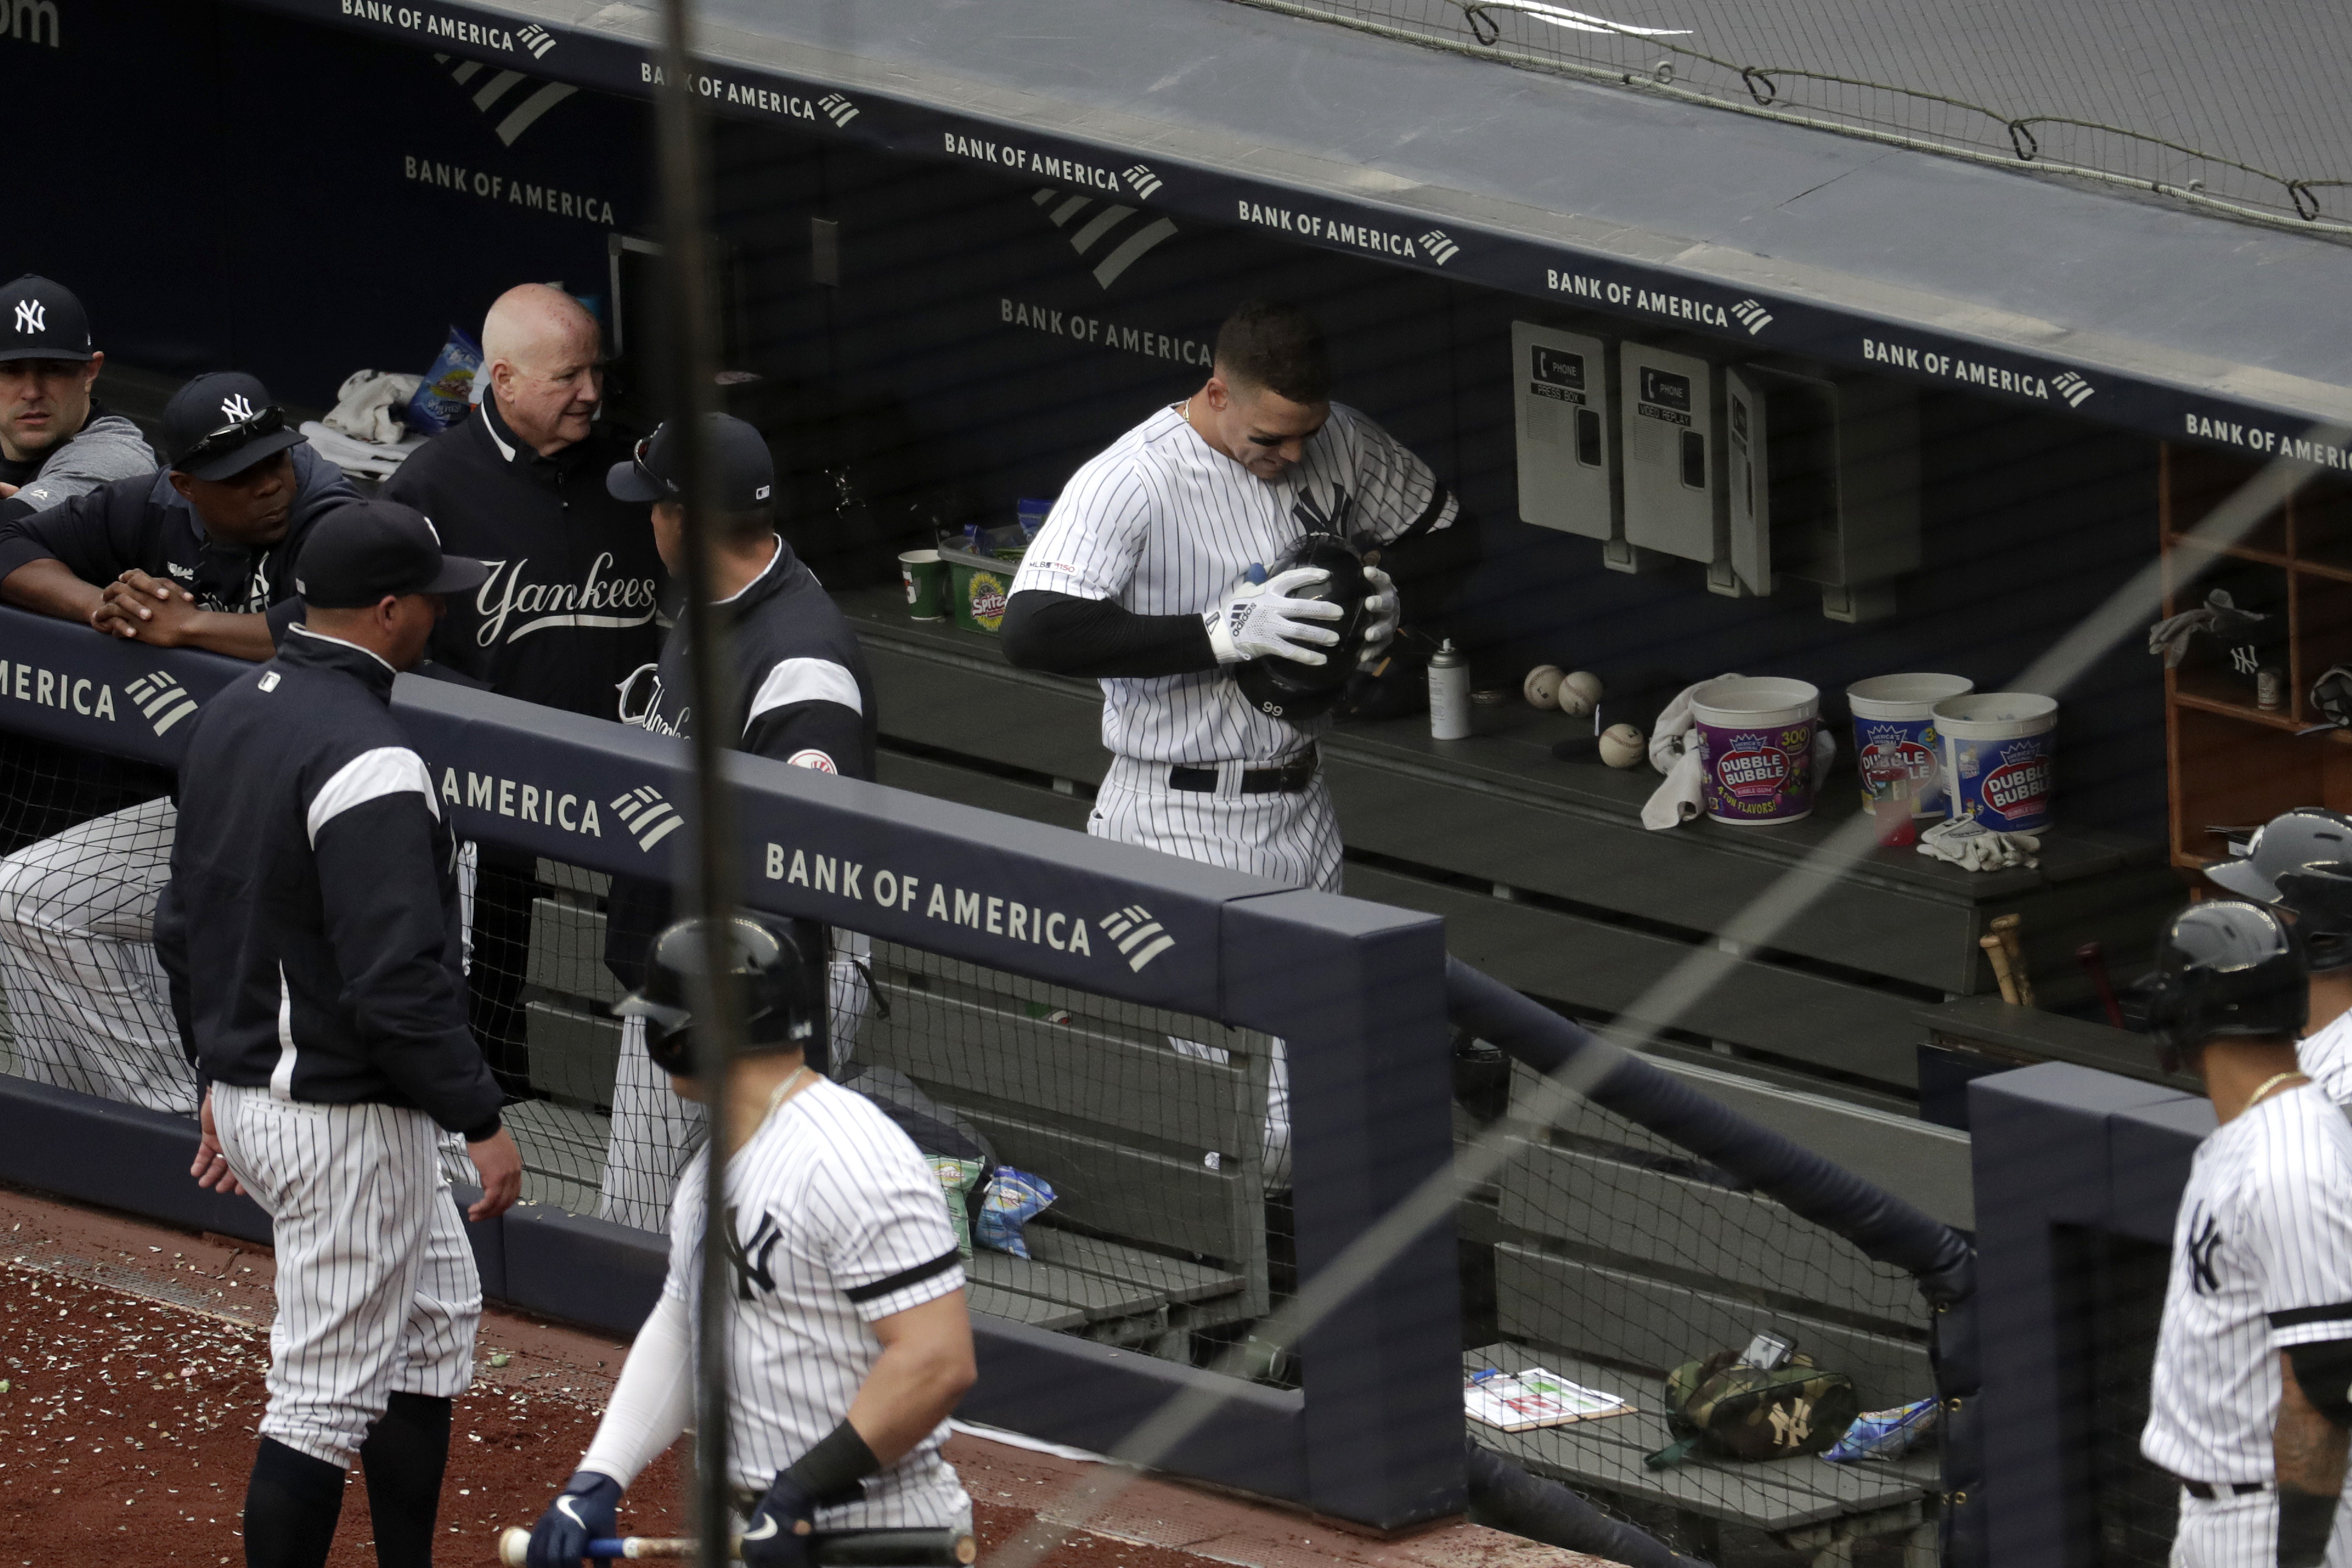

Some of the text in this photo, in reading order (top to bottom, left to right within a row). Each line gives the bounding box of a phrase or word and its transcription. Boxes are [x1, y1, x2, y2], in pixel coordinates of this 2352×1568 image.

[342, 0, 514, 52] BANK OF AMERICA
[641, 62, 815, 120] BAK OF AMERICA
[945, 132, 1119, 192] BANK OF AMERICA
[405, 155, 614, 225] BANK OF AMERICA
[1239, 201, 1416, 258] BANK OF AMERICA
[1547, 269, 1728, 328] BANK OF AMERICA
[1002, 298, 1213, 368] BANK OF AMERICA
[1553, 362, 1577, 377] PHONE
[1660, 383, 1683, 397] PHONE
[1863, 338, 2049, 400] BANK OF AMERICA
[1538, 385, 1579, 403] PRESS BOX
[1641, 405, 1690, 425] VIDEO REPLAY
[2185, 413, 2352, 471] BANK OF AMERI
[476, 552, 657, 647] Yankees
[1233, 602, 1257, 637] adidas
[1262, 701, 1284, 717] 99
[1781, 729, 1806, 746] 300
[1721, 754, 1781, 773] DUBBLE
[1725, 766, 1784, 786] BUBBLE
[1987, 763, 2052, 793] DUBBLE
[442, 767, 601, 837] AMERICA
[1738, 799, 1778, 814] FLAVORS!
[1992, 777, 2052, 808] BUBBLE
[766, 842, 1091, 957] BANK OF AMERICA
